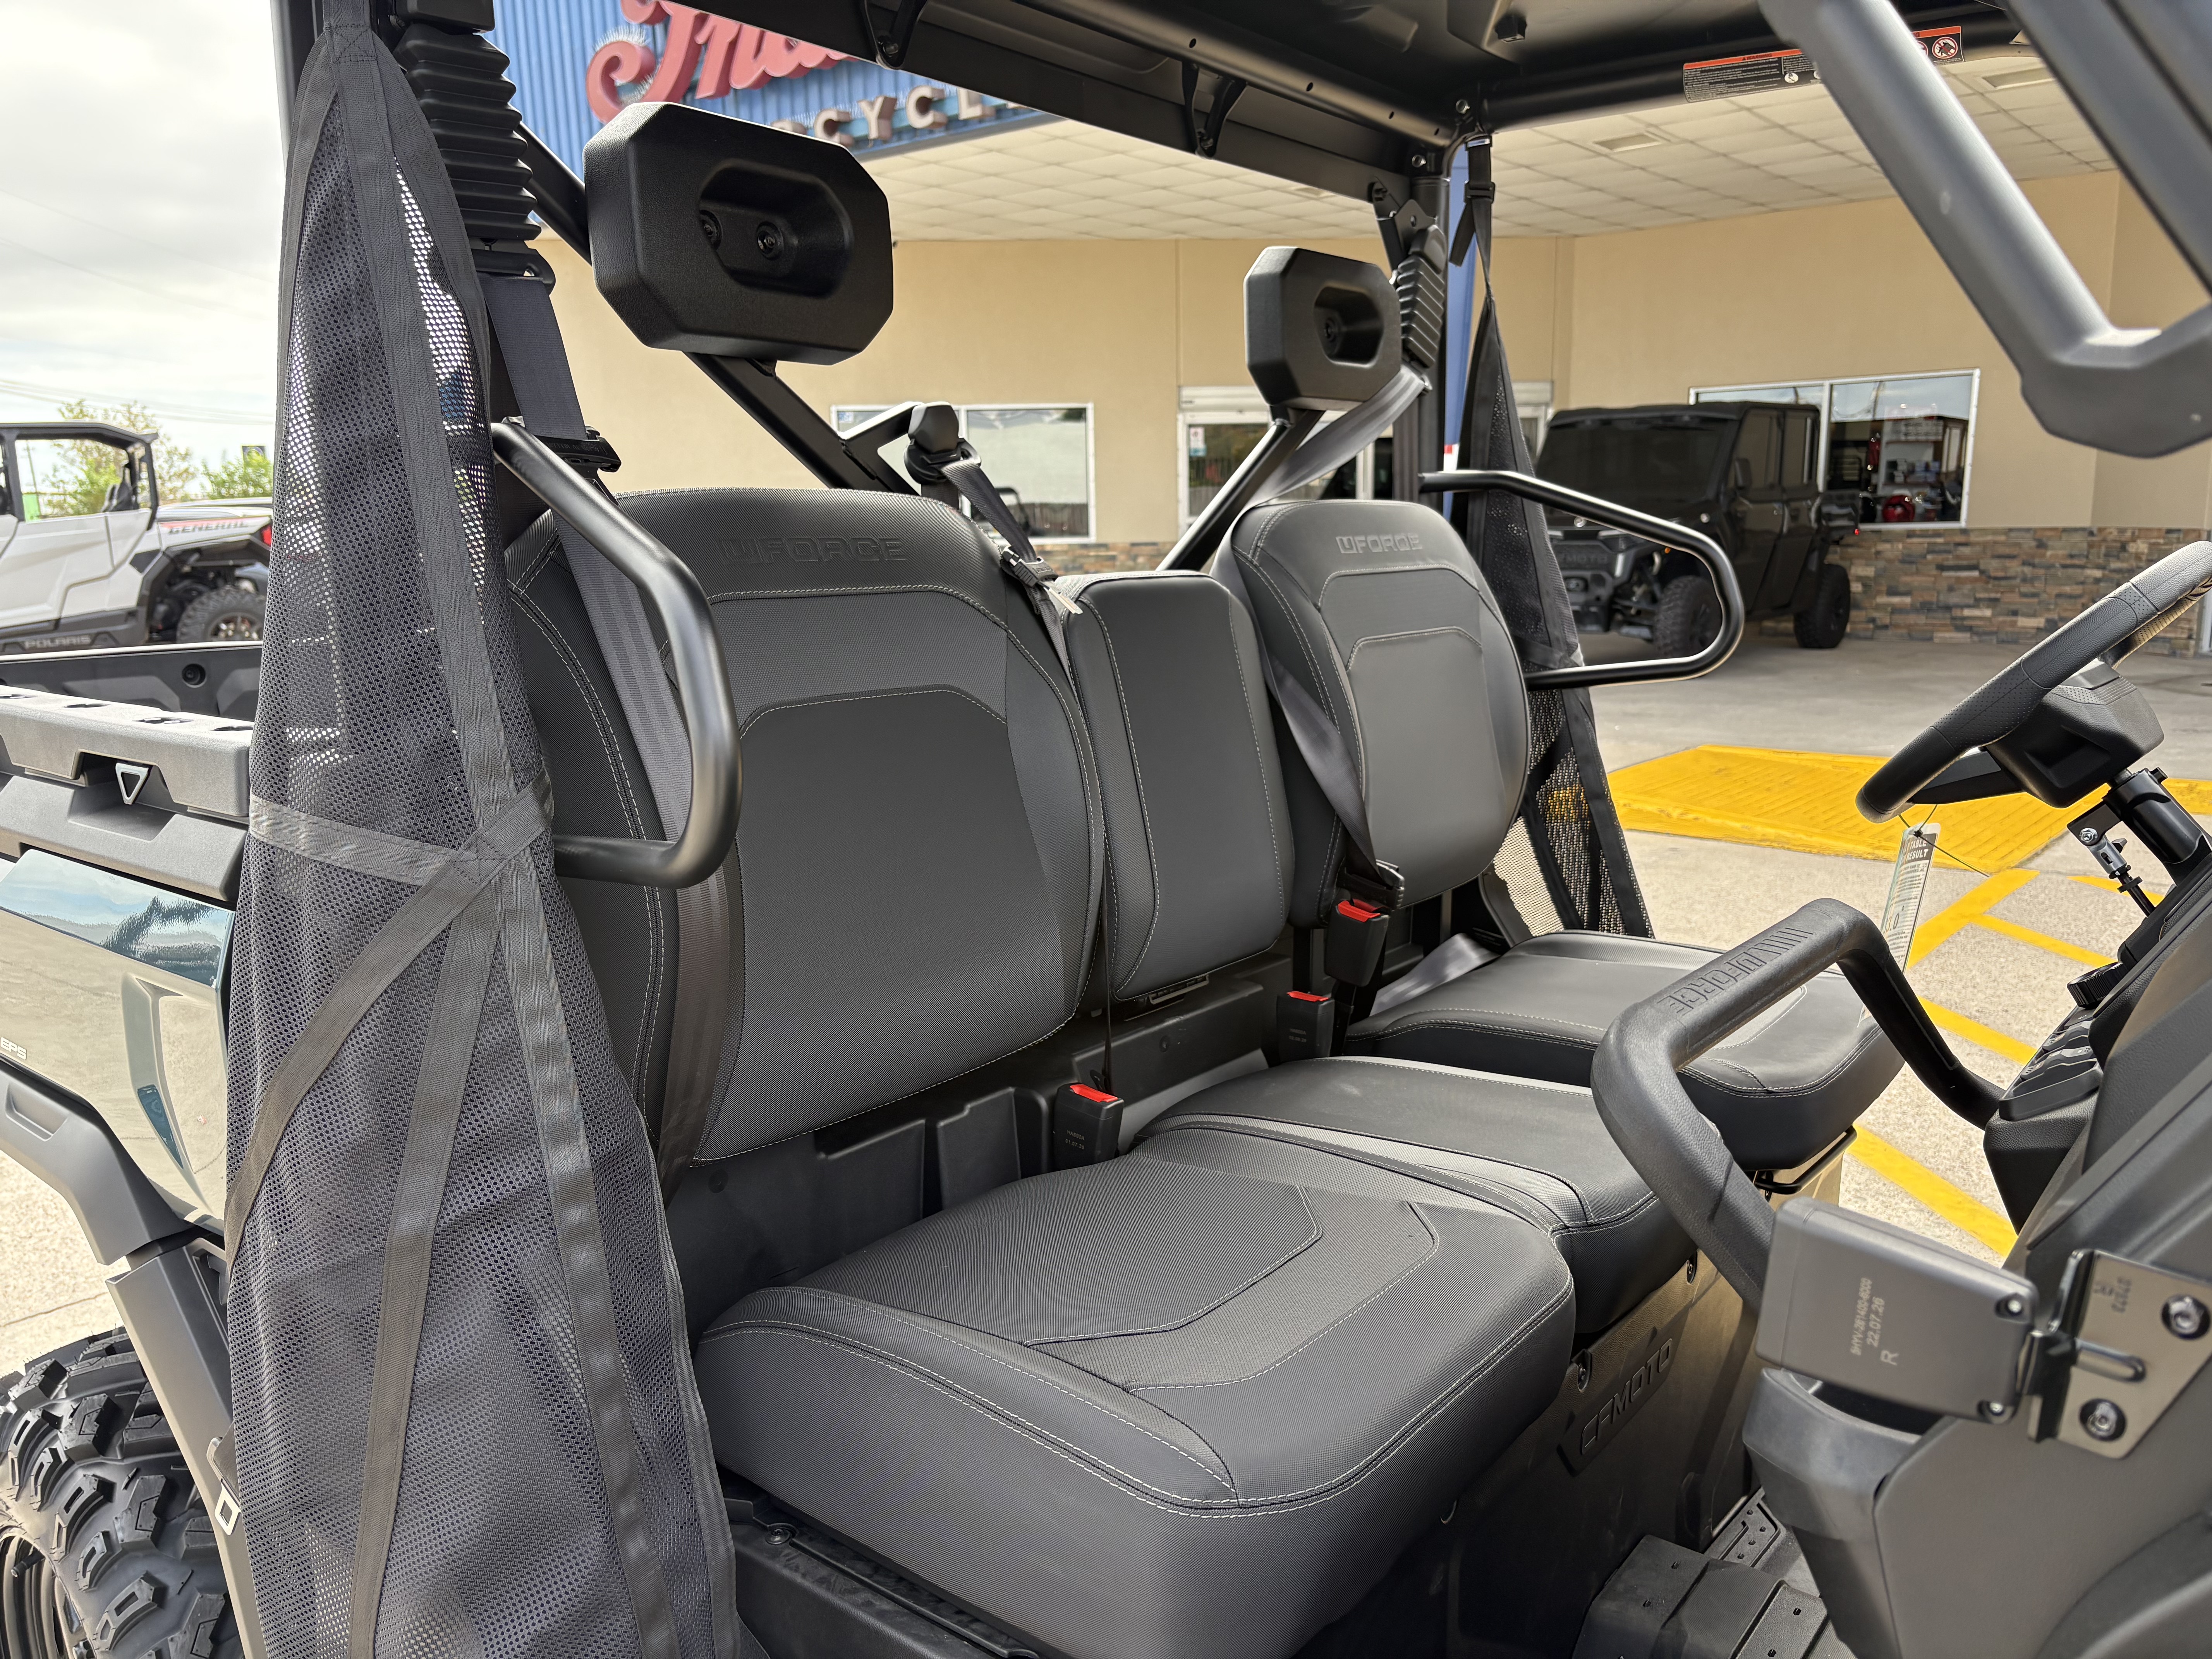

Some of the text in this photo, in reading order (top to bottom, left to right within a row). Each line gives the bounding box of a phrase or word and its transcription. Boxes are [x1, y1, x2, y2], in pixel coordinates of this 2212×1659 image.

[168, 521, 249, 534] GENERAL
[715, 537, 907, 564] UFORCE
[1336, 533, 1423, 554] UFORCE
[24, 635, 91, 649] POLARIS
[1906, 849, 1929, 861] RESULT
[0, 1037, 27, 1060] EPS
[1880, 1350, 1899, 1365] R
[1580, 1338, 1672, 1455] CFMOTO
